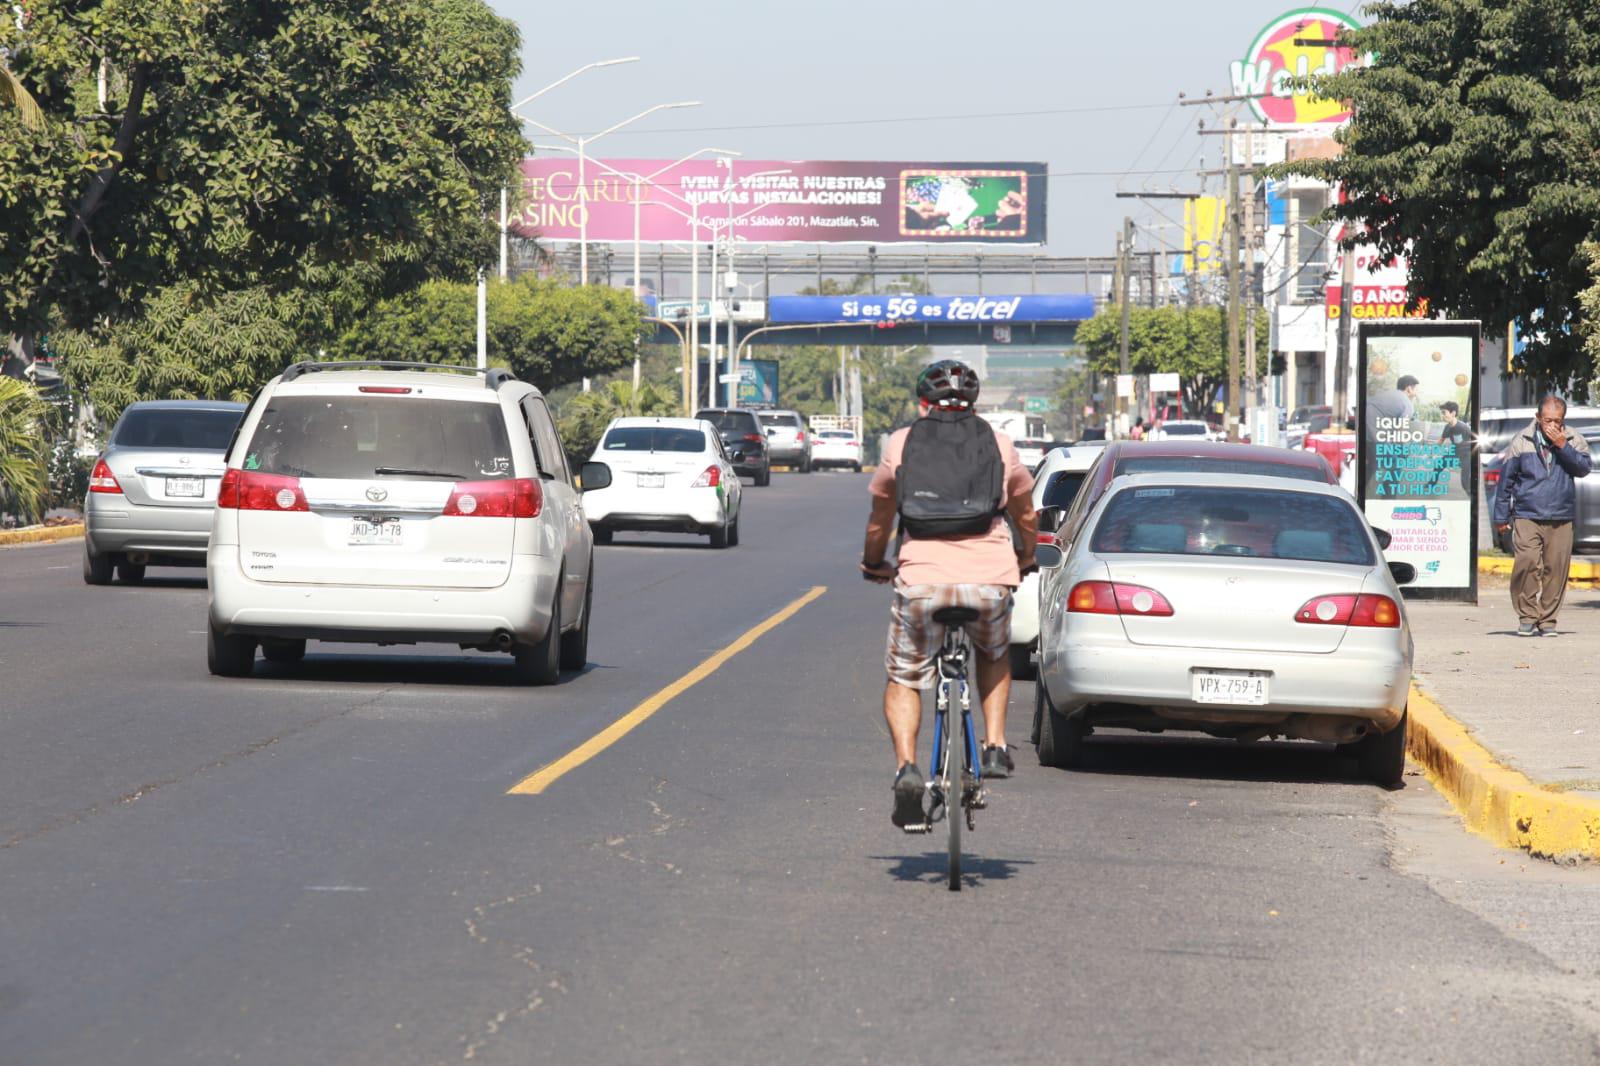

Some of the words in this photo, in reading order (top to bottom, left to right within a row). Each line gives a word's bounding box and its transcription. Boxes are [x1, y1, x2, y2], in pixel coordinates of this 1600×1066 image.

[739, 176, 799, 189] VISITAR
[803, 176, 886, 190] NUESTRAS
[685, 191, 749, 204] NUEVAS
[754, 191, 882, 205] INSTALACIONES!
[508, 202, 589, 228] ASINO
[750, 215, 785, 227] Sábalo
[786, 215, 809, 228] 201,
[860, 215, 879, 228] Sin.
[842, 301, 858, 317] Si
[862, 303, 882, 317] es
[886, 298, 917, 319] 5G
[922, 303, 942, 317] es
[947, 297, 1021, 320] telcel
[1376, 415, 1411, 429] ¡QUÉ
[1376, 430, 1423, 443] CHIDO
[1376, 443, 1456, 456] ENSEÑARLE
[1376, 457, 1393, 469] TU
[1397, 457, 1461, 470] DEPORTE
[1376, 470, 1451, 482] FAVORITO
[1375, 484, 1386, 495] A
[1389, 484, 1406, 495] TU
[1410, 484, 1449, 496] HIJO!
